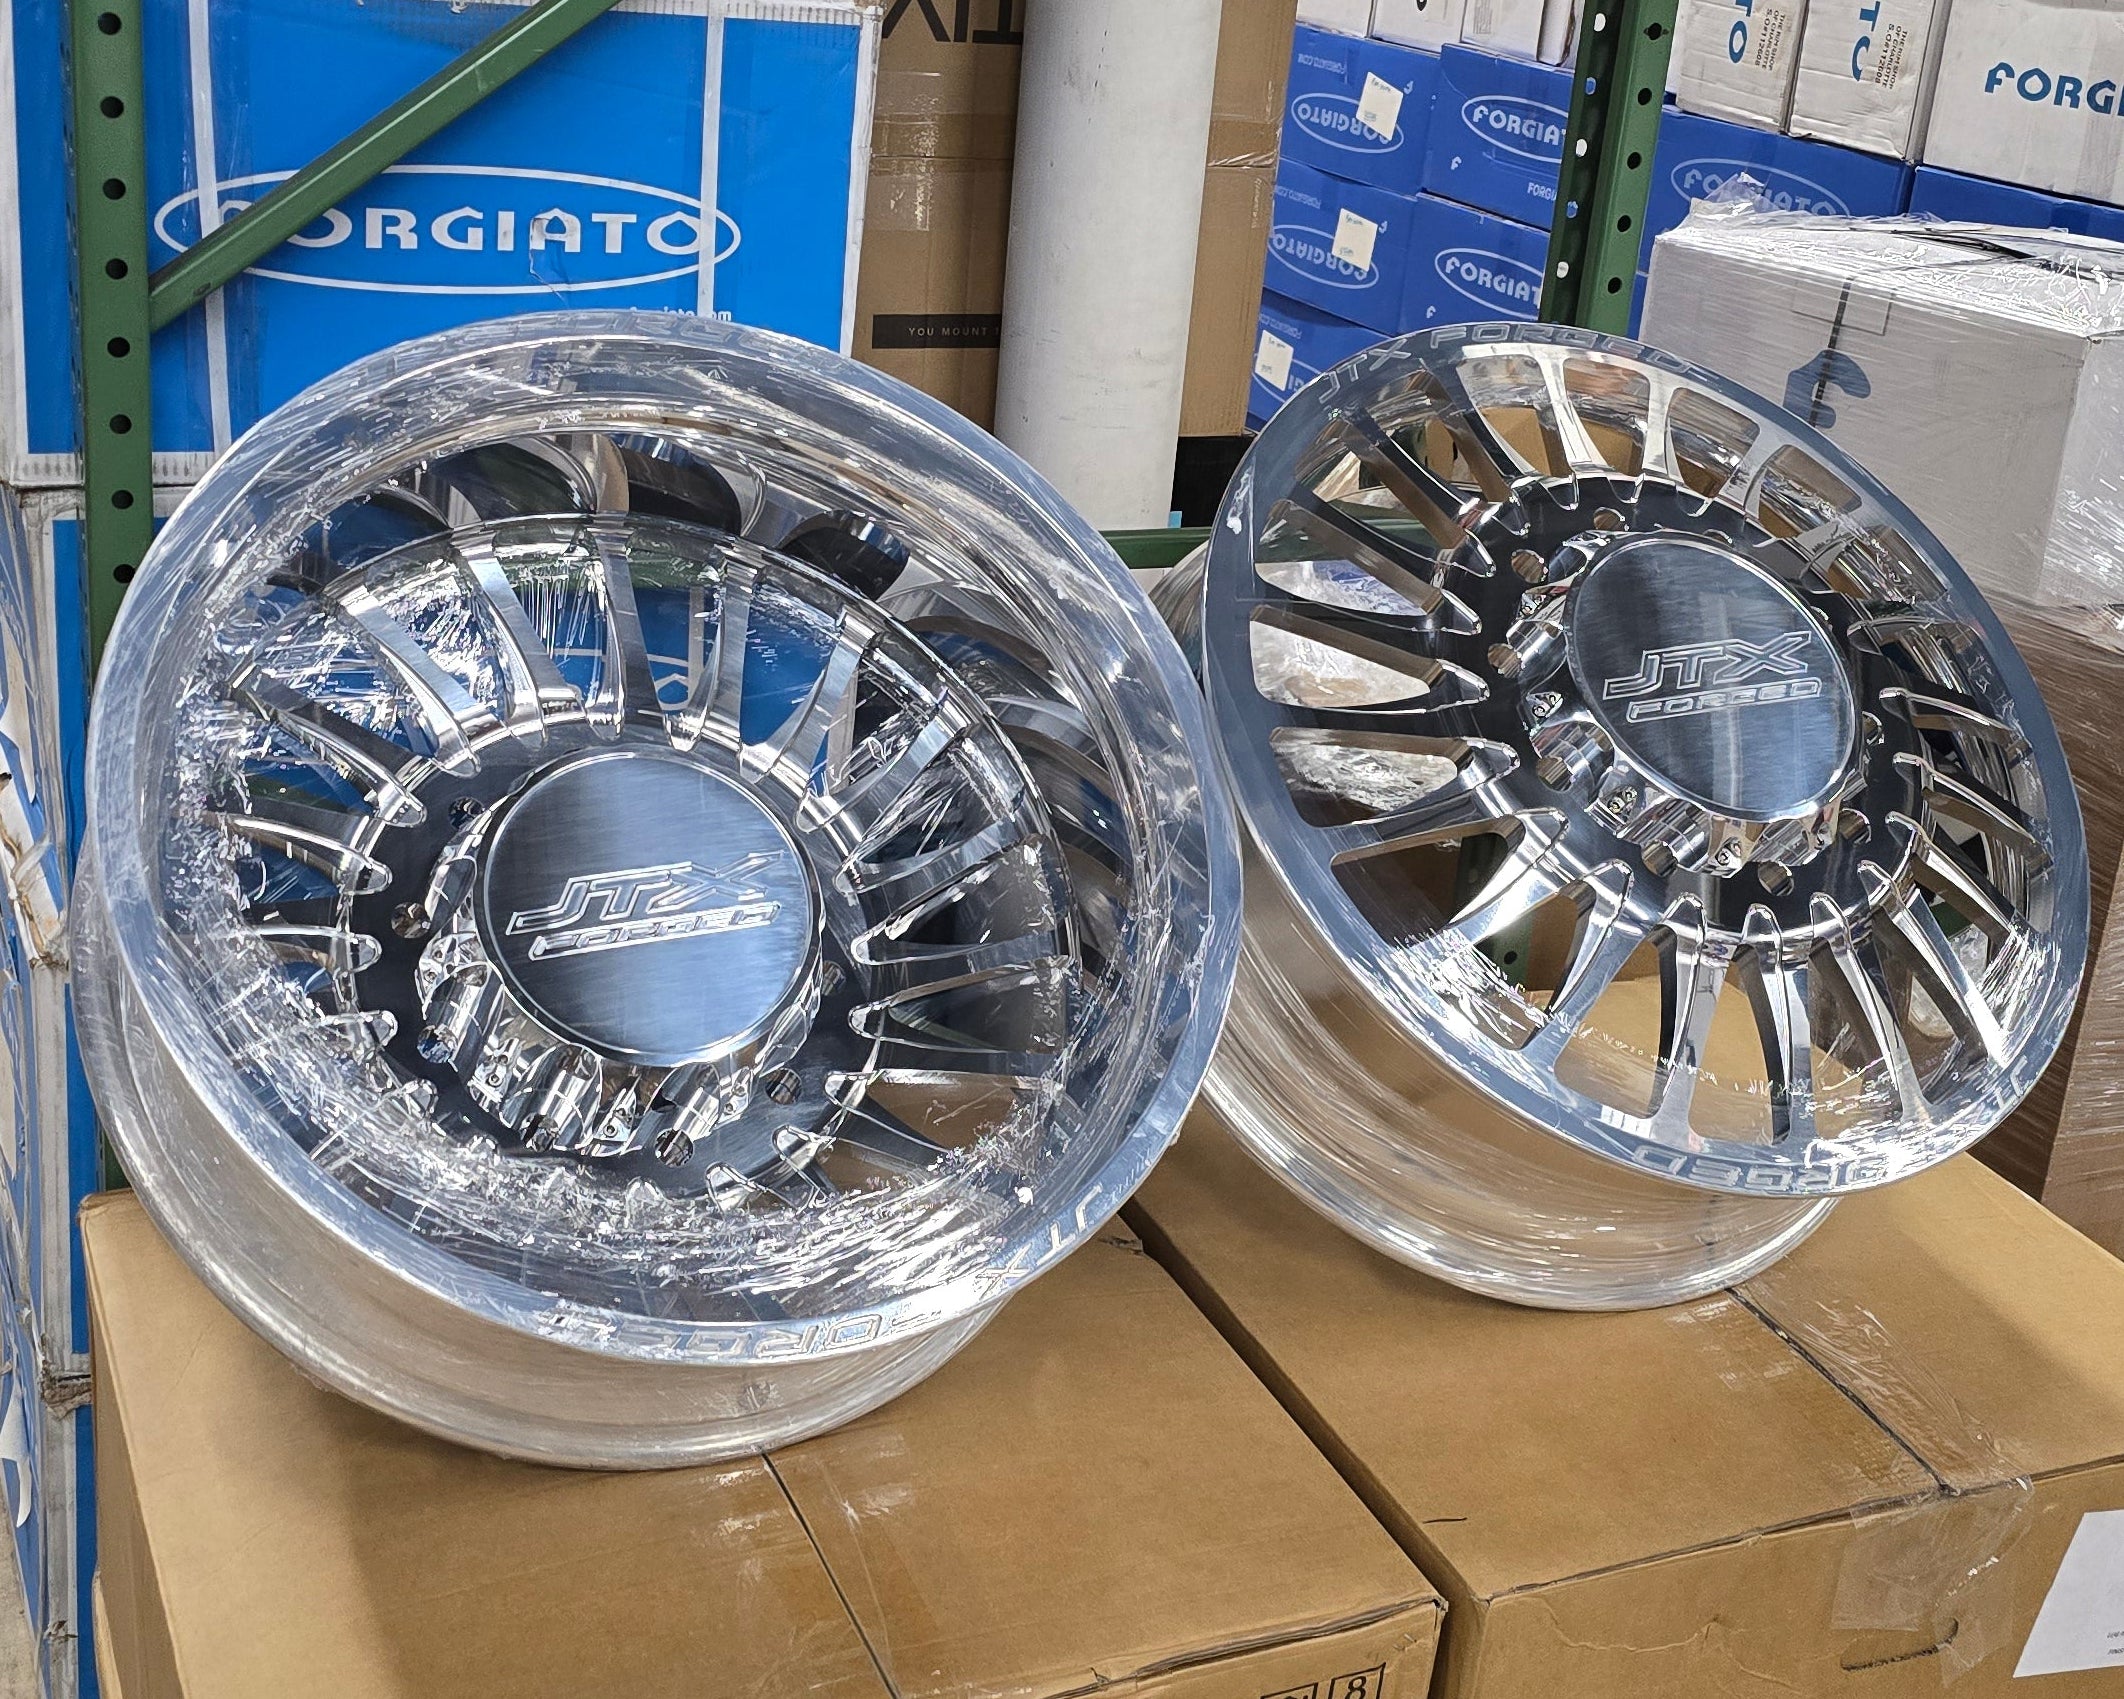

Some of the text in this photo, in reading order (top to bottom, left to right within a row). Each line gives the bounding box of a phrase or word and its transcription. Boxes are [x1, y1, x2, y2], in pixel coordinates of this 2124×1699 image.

[1761, 23, 1776, 68] CHARLOTTE
[1767, 47, 1777, 70] SHOP
[1881, 39, 1898, 88] CHARLOTTE
[1888, 65, 1898, 89] SHOP
[218, 199, 708, 257] ORGIATO
[908, 327, 934, 337] YOU
[941, 326, 989, 337] MOUNT
[1430, 325, 1690, 374] FORGED
[1603, 630, 1812, 700] JTX
[1630, 680, 1821, 720] FORGED
[505, 850, 784, 936] JTX
[1632, 1144, 1900, 1193] ORGED
